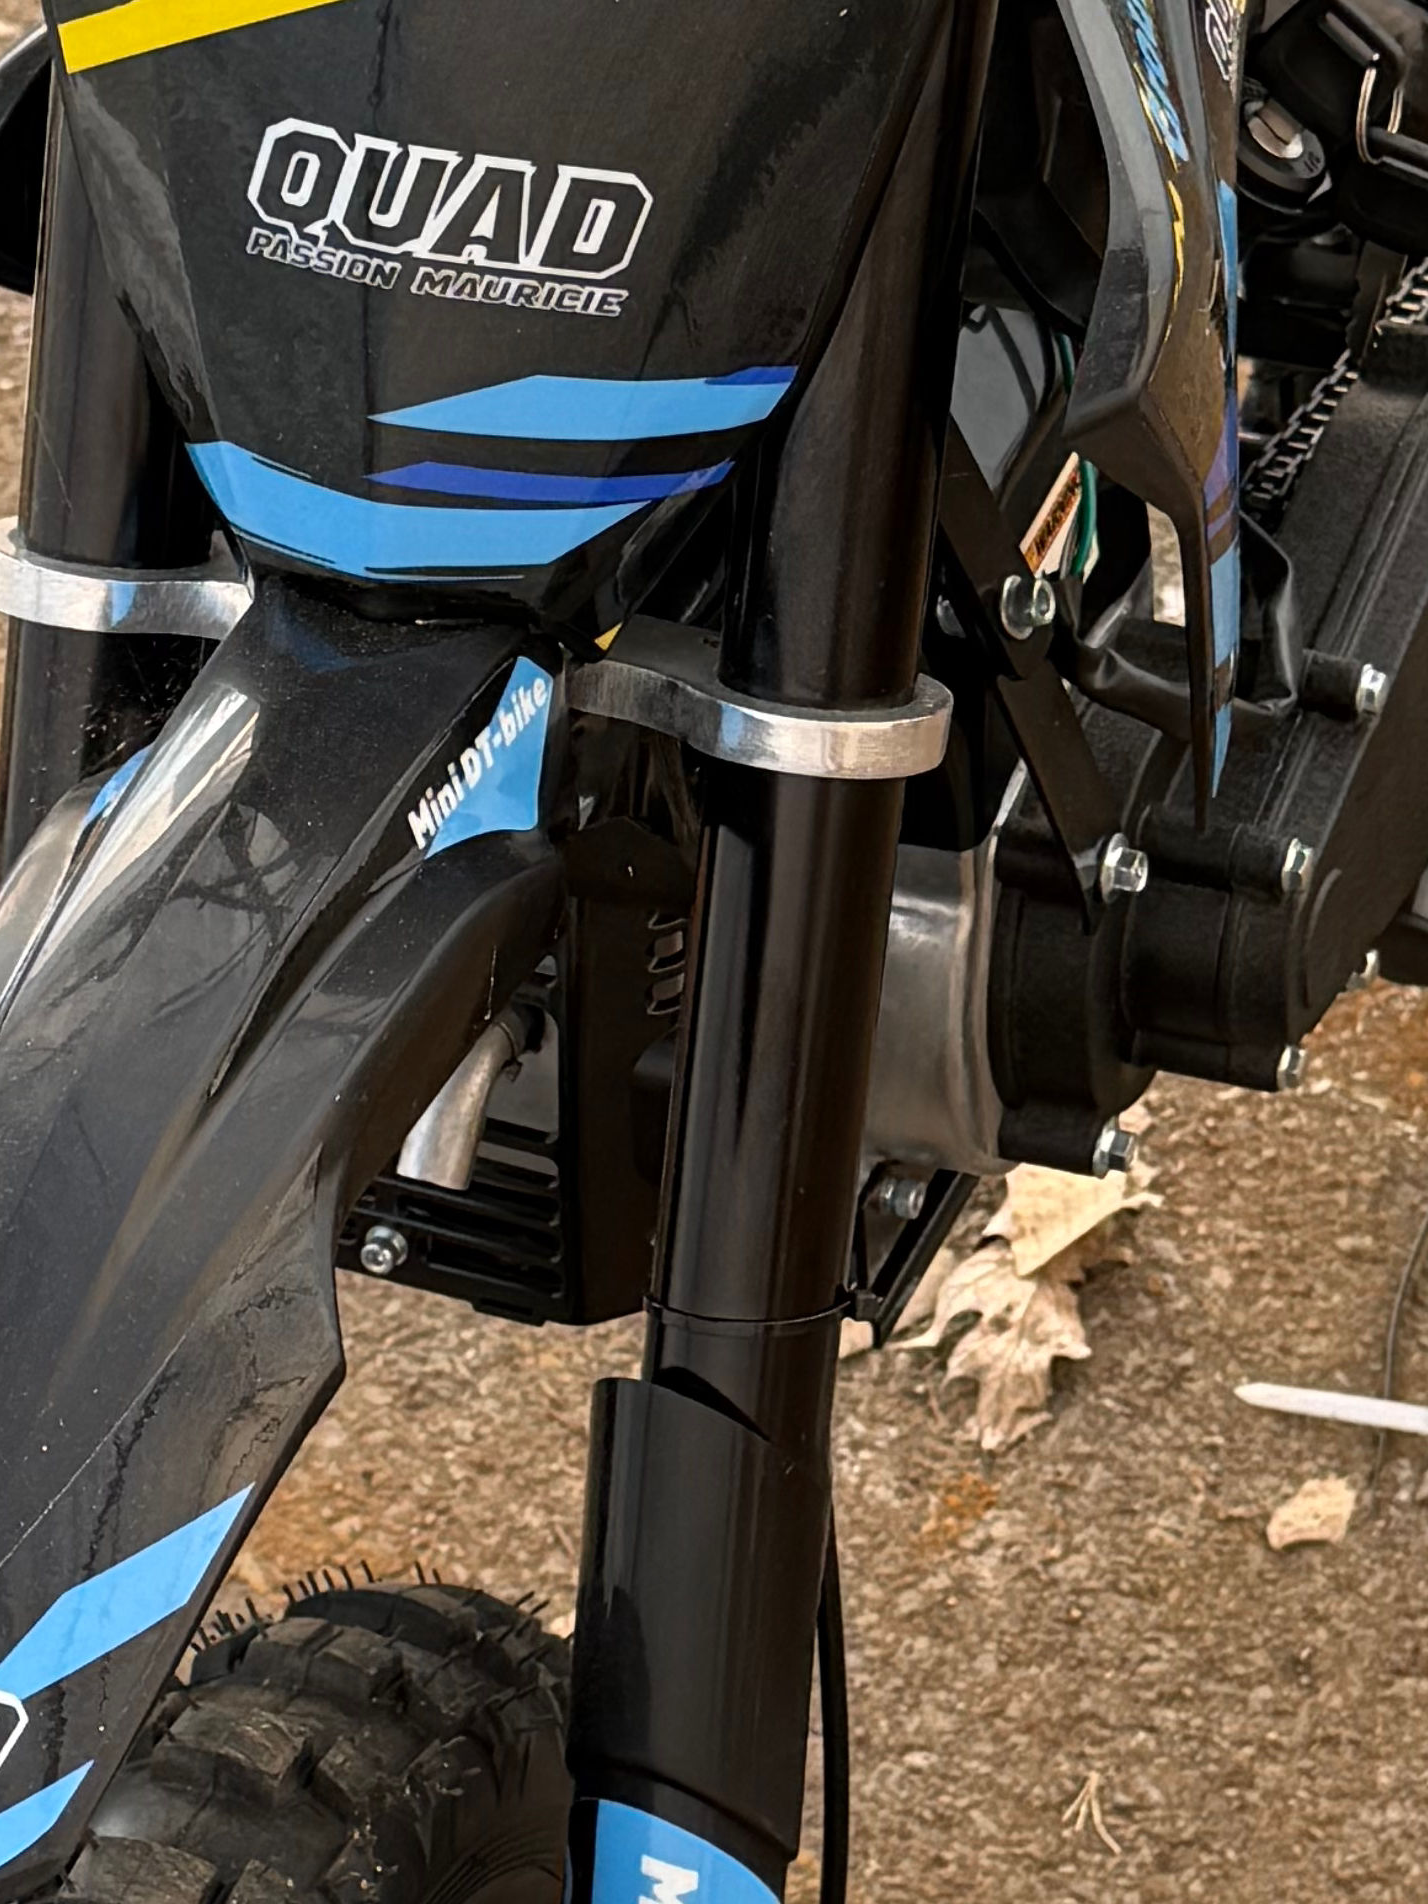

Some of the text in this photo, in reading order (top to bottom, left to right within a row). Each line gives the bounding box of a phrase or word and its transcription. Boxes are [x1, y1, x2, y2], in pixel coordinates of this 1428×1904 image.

[246, 226, 629, 316] PASSION MAURICIE
[247, 117, 654, 279] QUAD
[407, 678, 548, 850] Mini DT-bike
